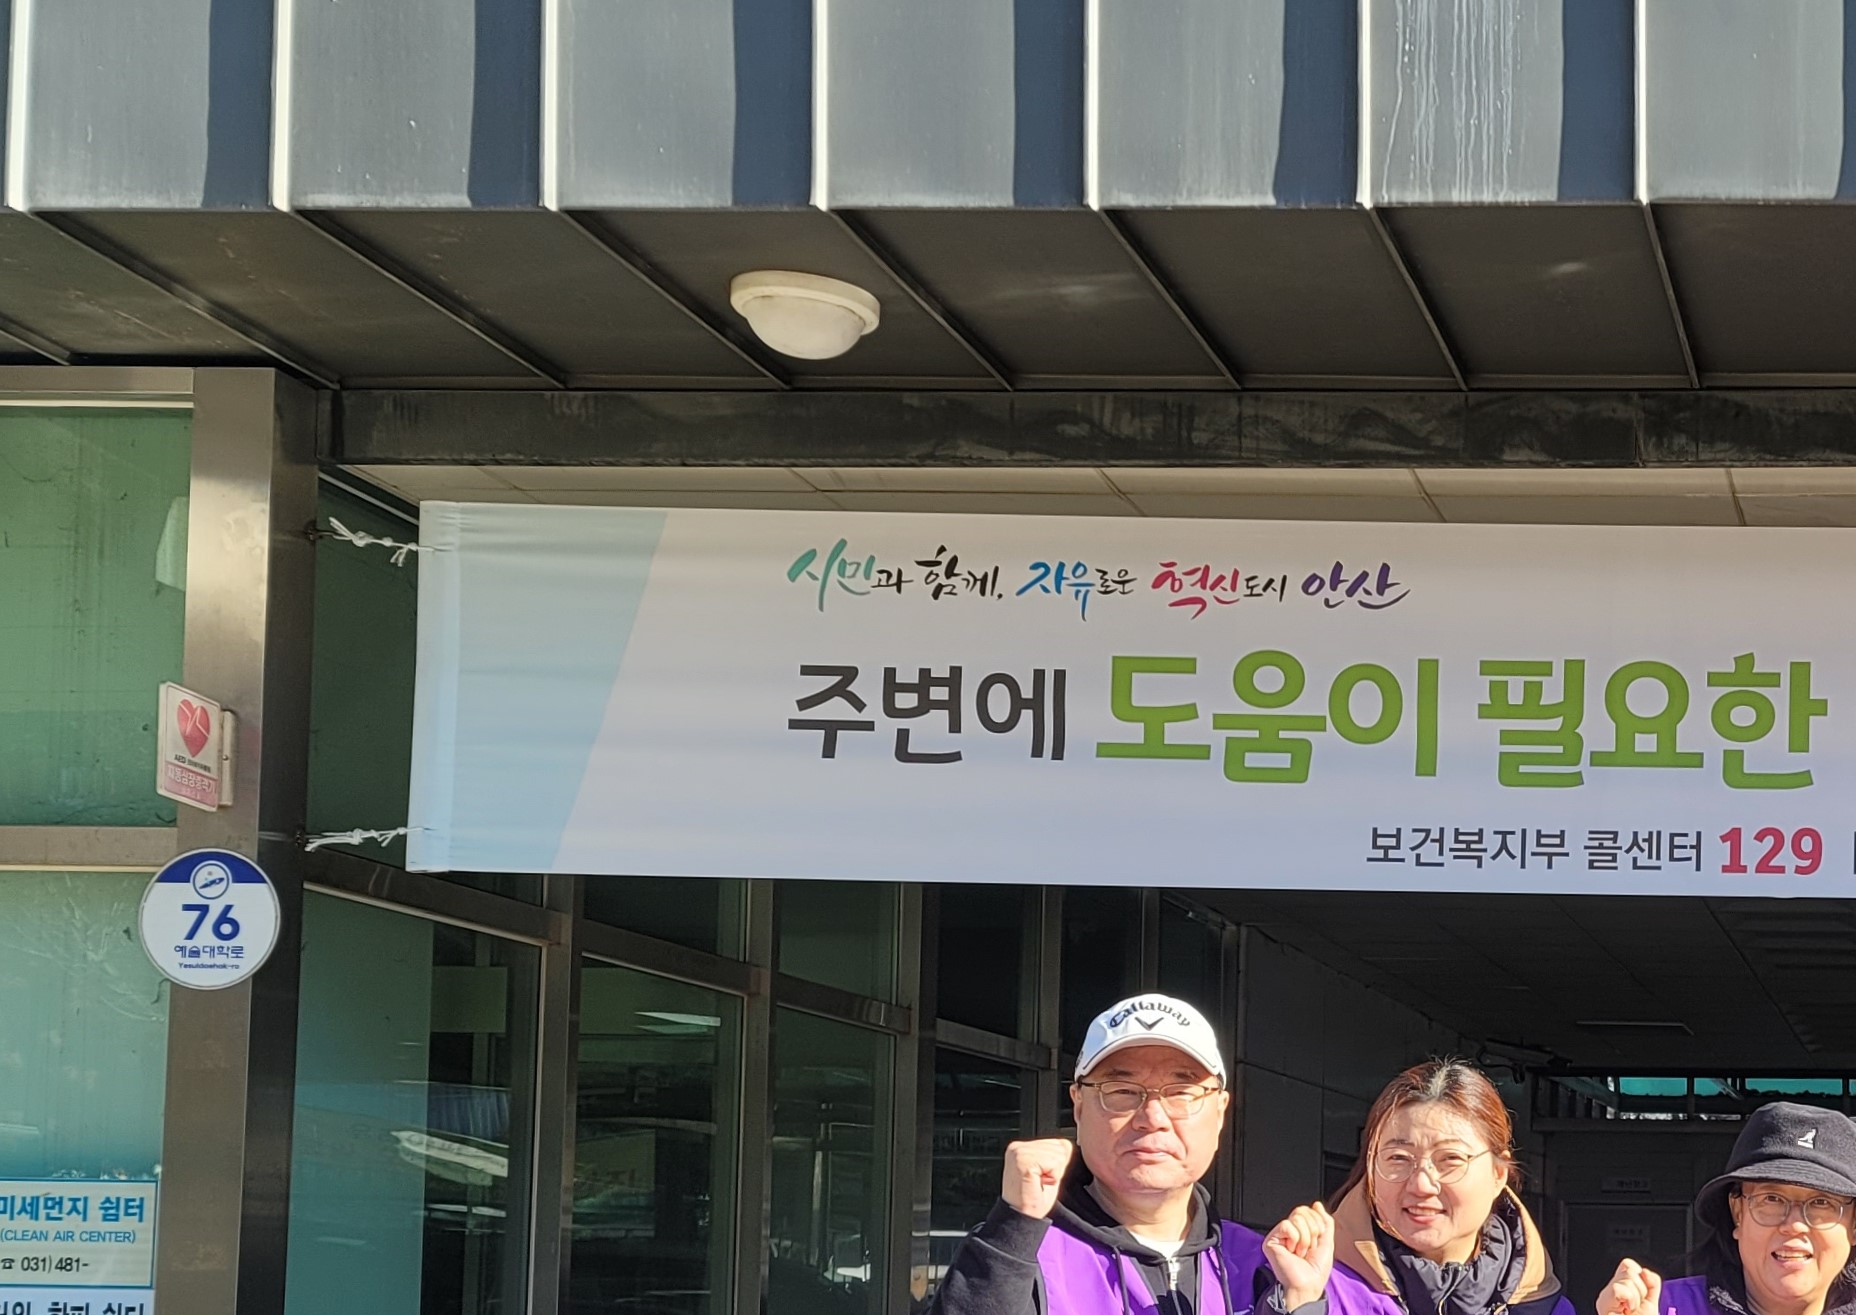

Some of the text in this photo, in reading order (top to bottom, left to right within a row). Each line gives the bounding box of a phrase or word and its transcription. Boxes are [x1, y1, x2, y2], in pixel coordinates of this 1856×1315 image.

[786, 538, 1410, 621] 시민과 함께. 자유로운 혁신도시 안산
[788, 664, 1066, 764] 주변에
[1095, 650, 1436, 783] 도움이
[1477, 651, 1828, 789] 필요한
[1366, 826, 1569, 871] 보건복지부
[1583, 827, 1703, 873] 콜센터
[1718, 826, 1823, 875] 129
[181, 904, 241, 941] 76
[174, 945, 244, 959] 예술대학로
[1110, 1000, 1191, 1028] Callaway
[0, 1196, 145, 1223] 미세먼지 쉼터
[53, 1230, 75, 1242] AIR
[79, 1230, 136, 1244] CENTER)
